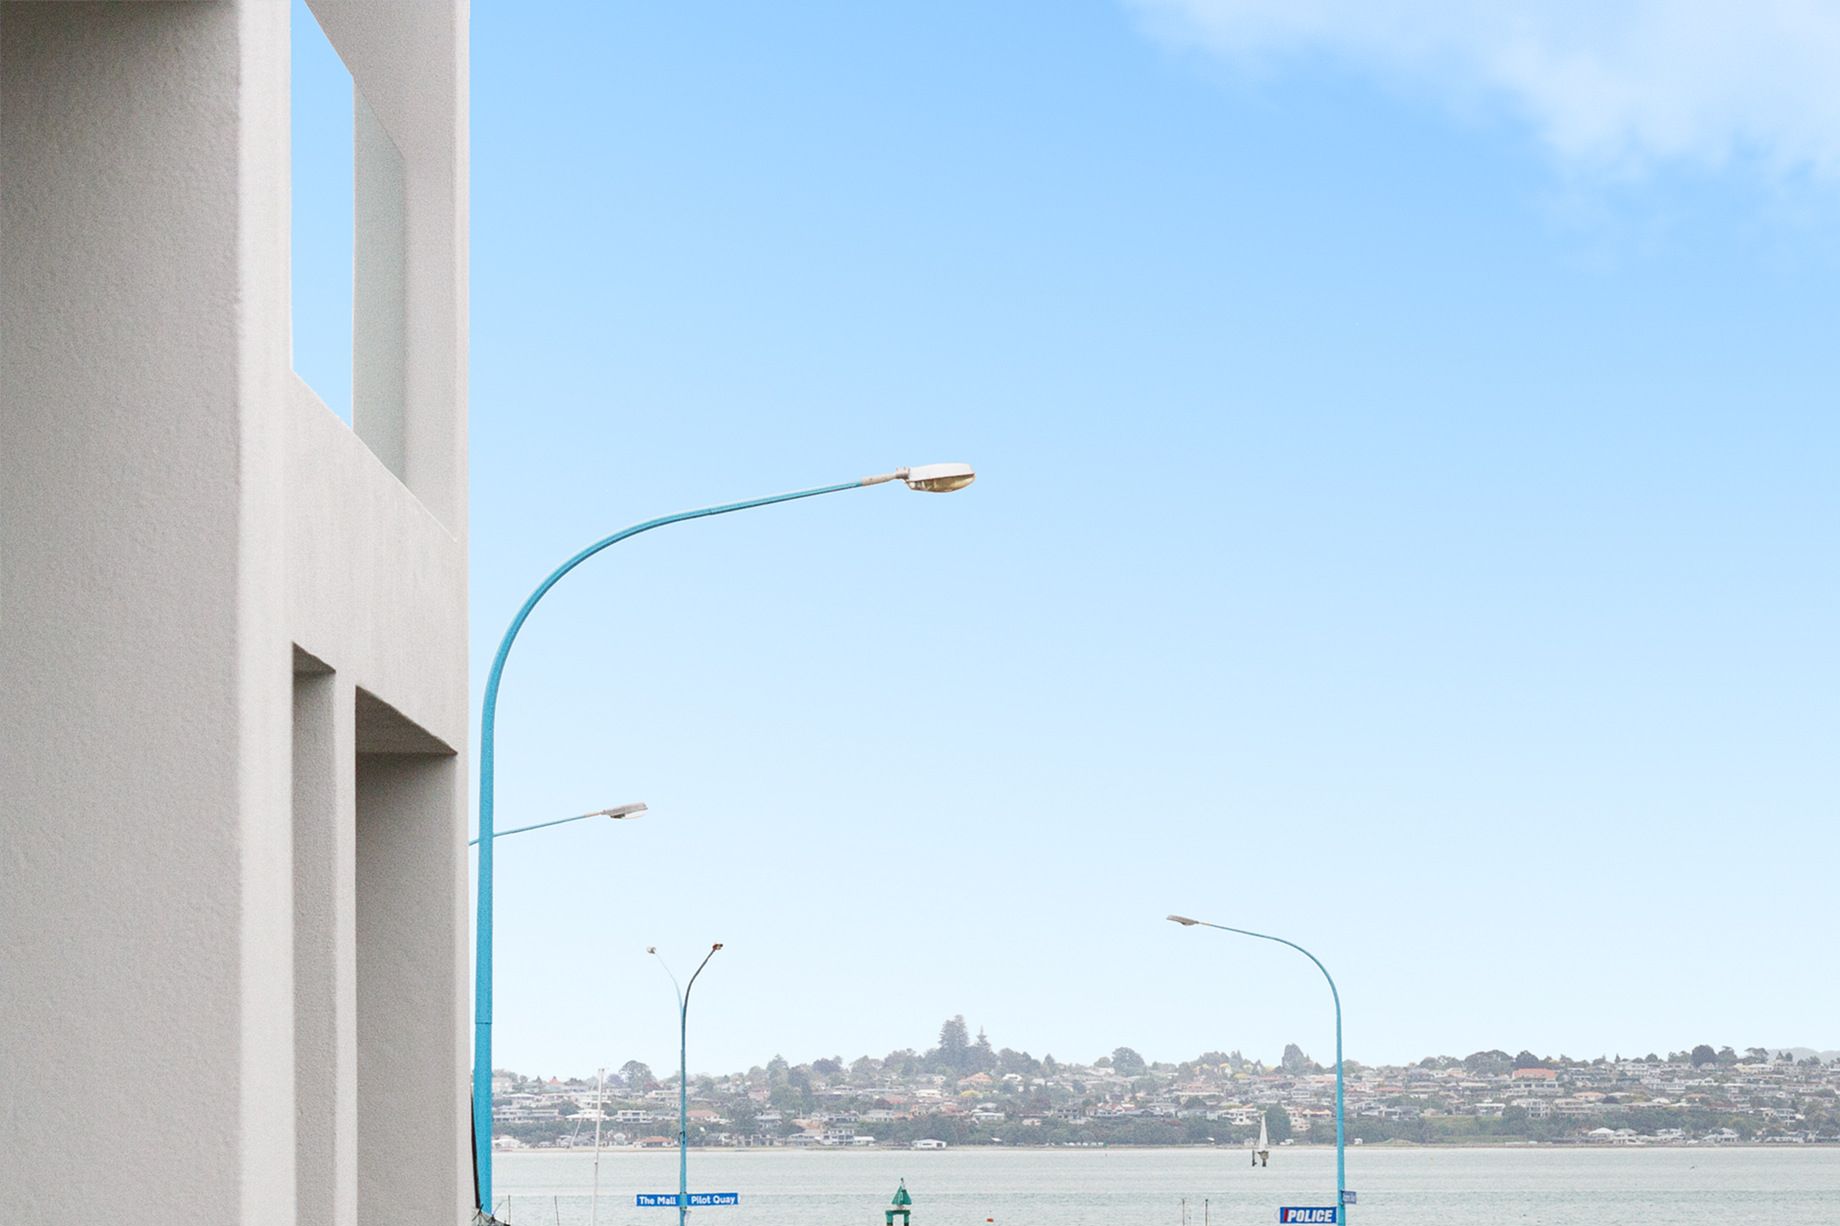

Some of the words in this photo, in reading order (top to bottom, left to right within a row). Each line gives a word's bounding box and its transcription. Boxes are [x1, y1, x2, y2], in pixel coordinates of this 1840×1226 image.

[639, 1196, 655, 1205] The
[657, 1196, 676, 1205] Mall
[691, 1195, 711, 1205] Pilot
[713, 1195, 735, 1205] Quay
[1287, 1209, 1333, 1222] POLICE
